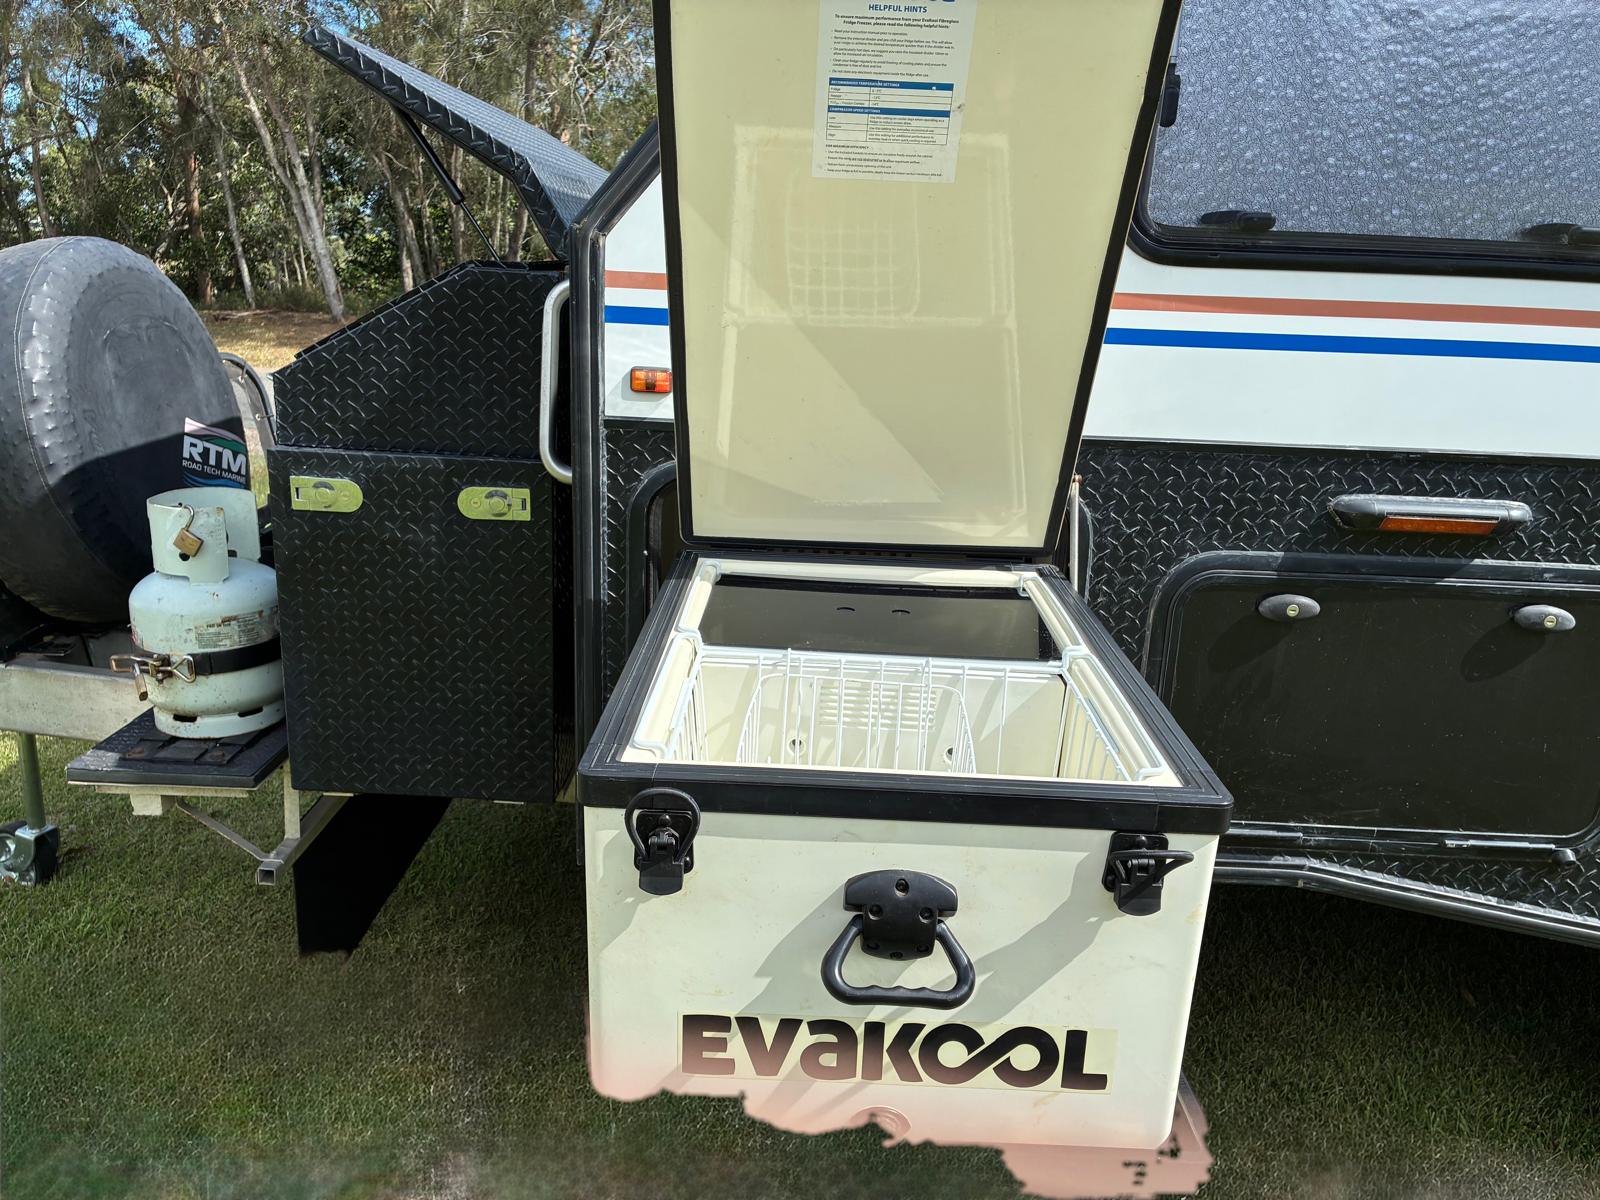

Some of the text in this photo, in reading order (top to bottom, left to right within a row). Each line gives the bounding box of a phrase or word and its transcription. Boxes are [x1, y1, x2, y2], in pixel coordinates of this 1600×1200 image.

[868, 4, 928, 13] HELPFUL HINTS
[183, 435, 246, 475] RTM
[182, 460, 246, 484] ROAD TECH MARINE
